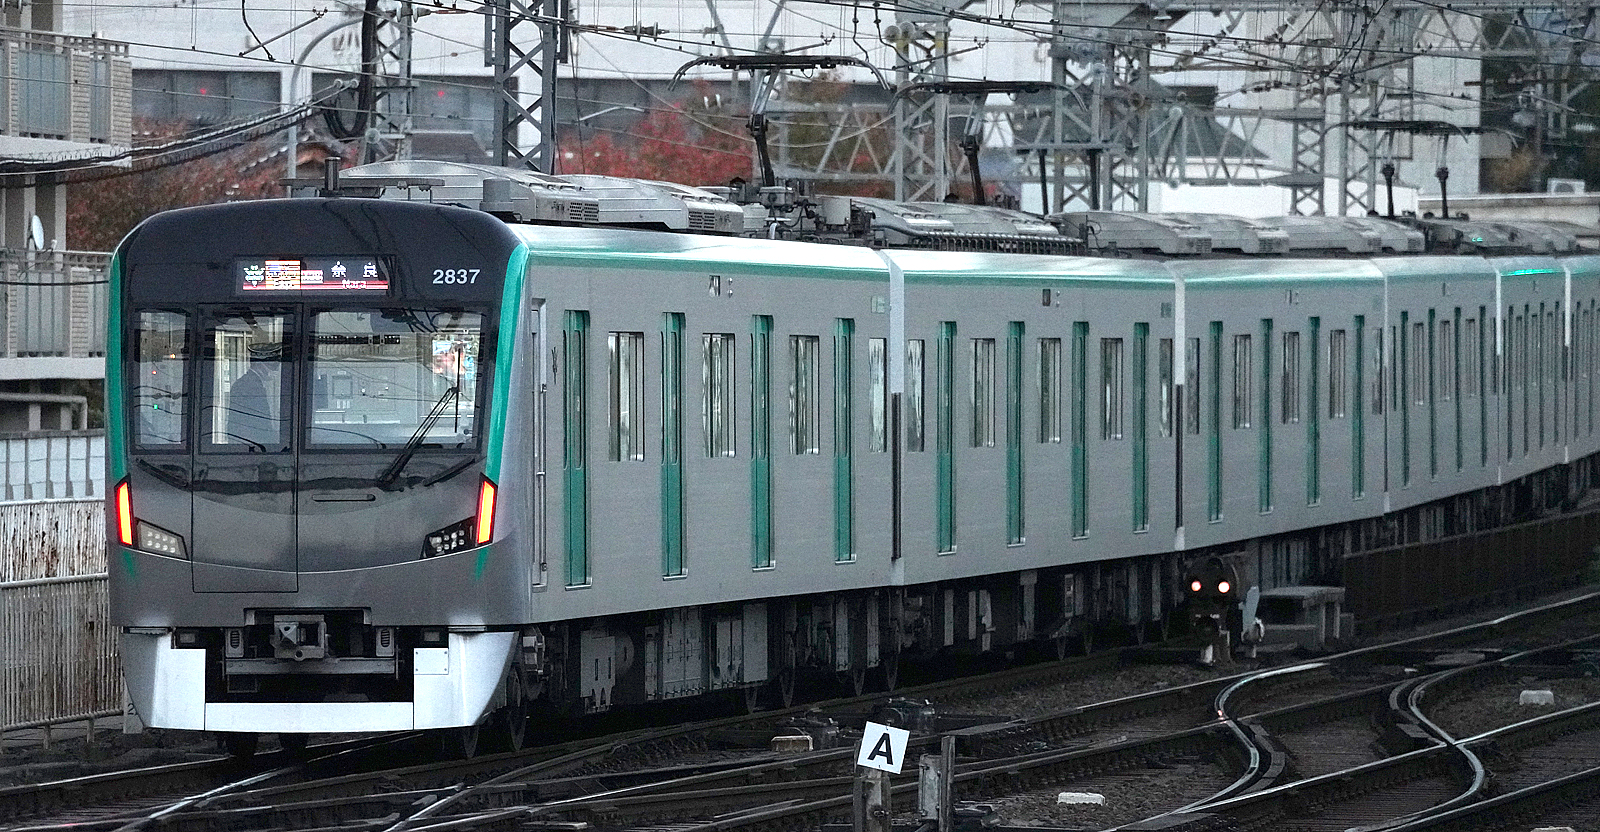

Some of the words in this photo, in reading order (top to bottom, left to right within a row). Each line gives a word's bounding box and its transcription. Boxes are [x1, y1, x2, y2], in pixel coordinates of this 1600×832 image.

[432, 269, 480, 284] 2837
[341, 279, 367, 290] Nara
[867, 733, 893, 765] A
